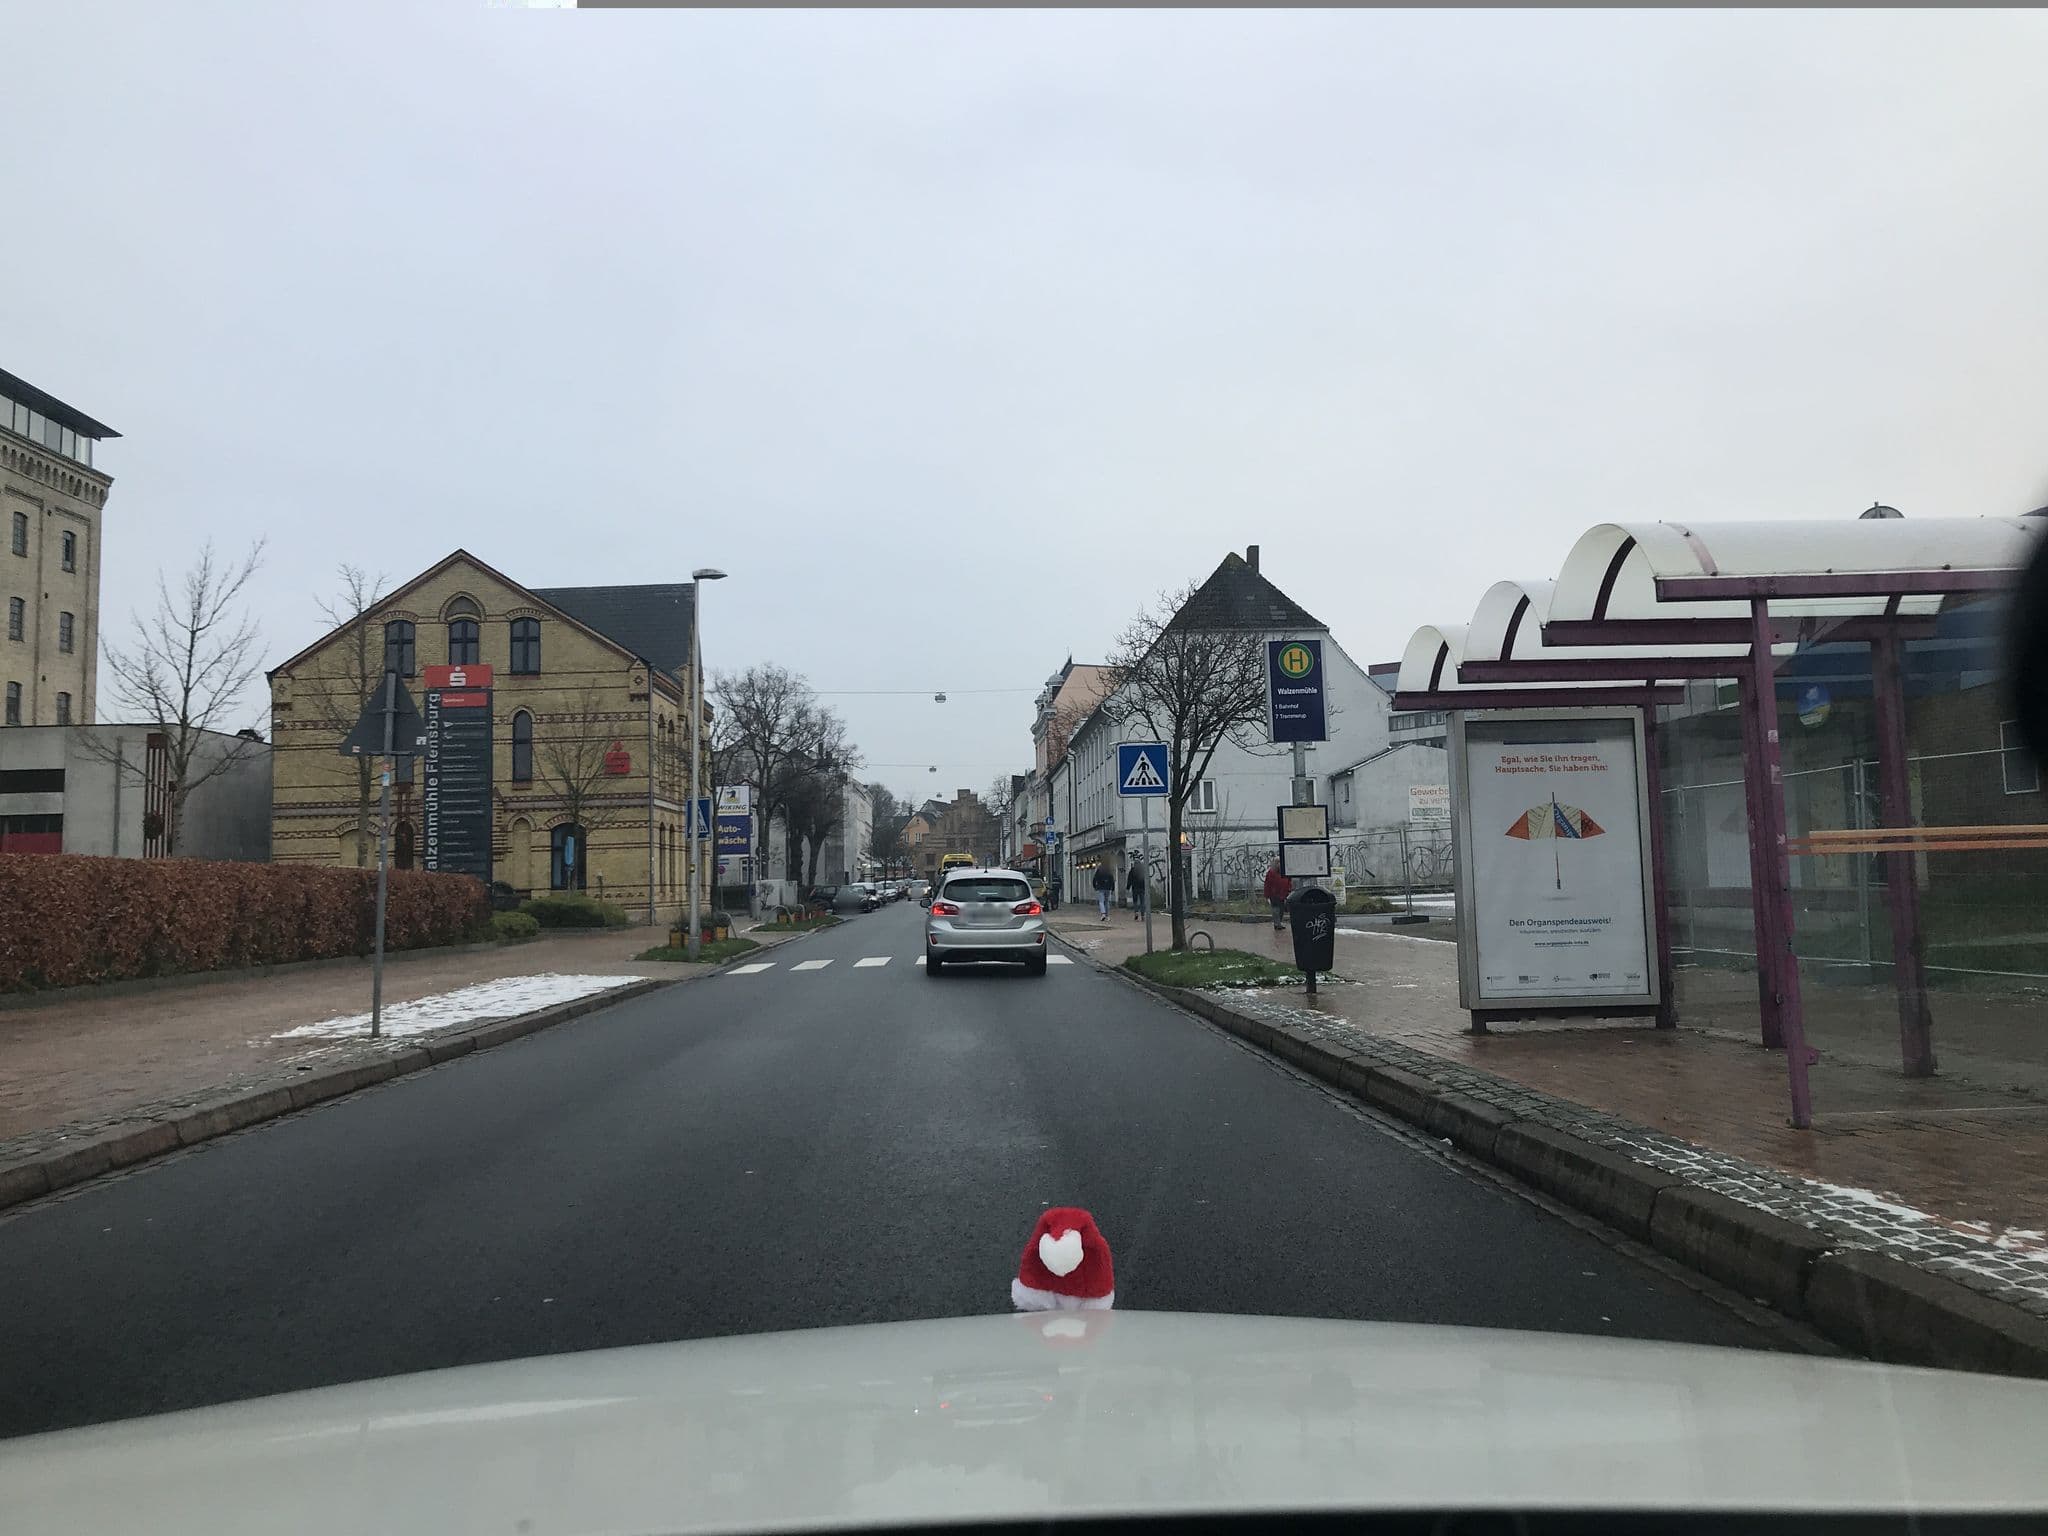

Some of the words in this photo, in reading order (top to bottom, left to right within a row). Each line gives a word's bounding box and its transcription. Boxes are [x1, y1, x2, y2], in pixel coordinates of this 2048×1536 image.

[1289, 651, 1304, 670] H
[1277, 686, 1318, 695] Walzenmühle
[426, 693, 440, 773] Flensburg
[1501, 756, 1522, 764] Egal,
[1571, 755, 1600, 763] tragen,
[1495, 765, 1547, 774] Hauptsache,
[1563, 764, 1589, 772] haben
[425, 778, 438, 871] alzenmühle
[718, 824, 741, 833] Auto-
[718, 836, 748, 845] wäsche
[1526, 917, 1612, 928] Organspendeausweis!
